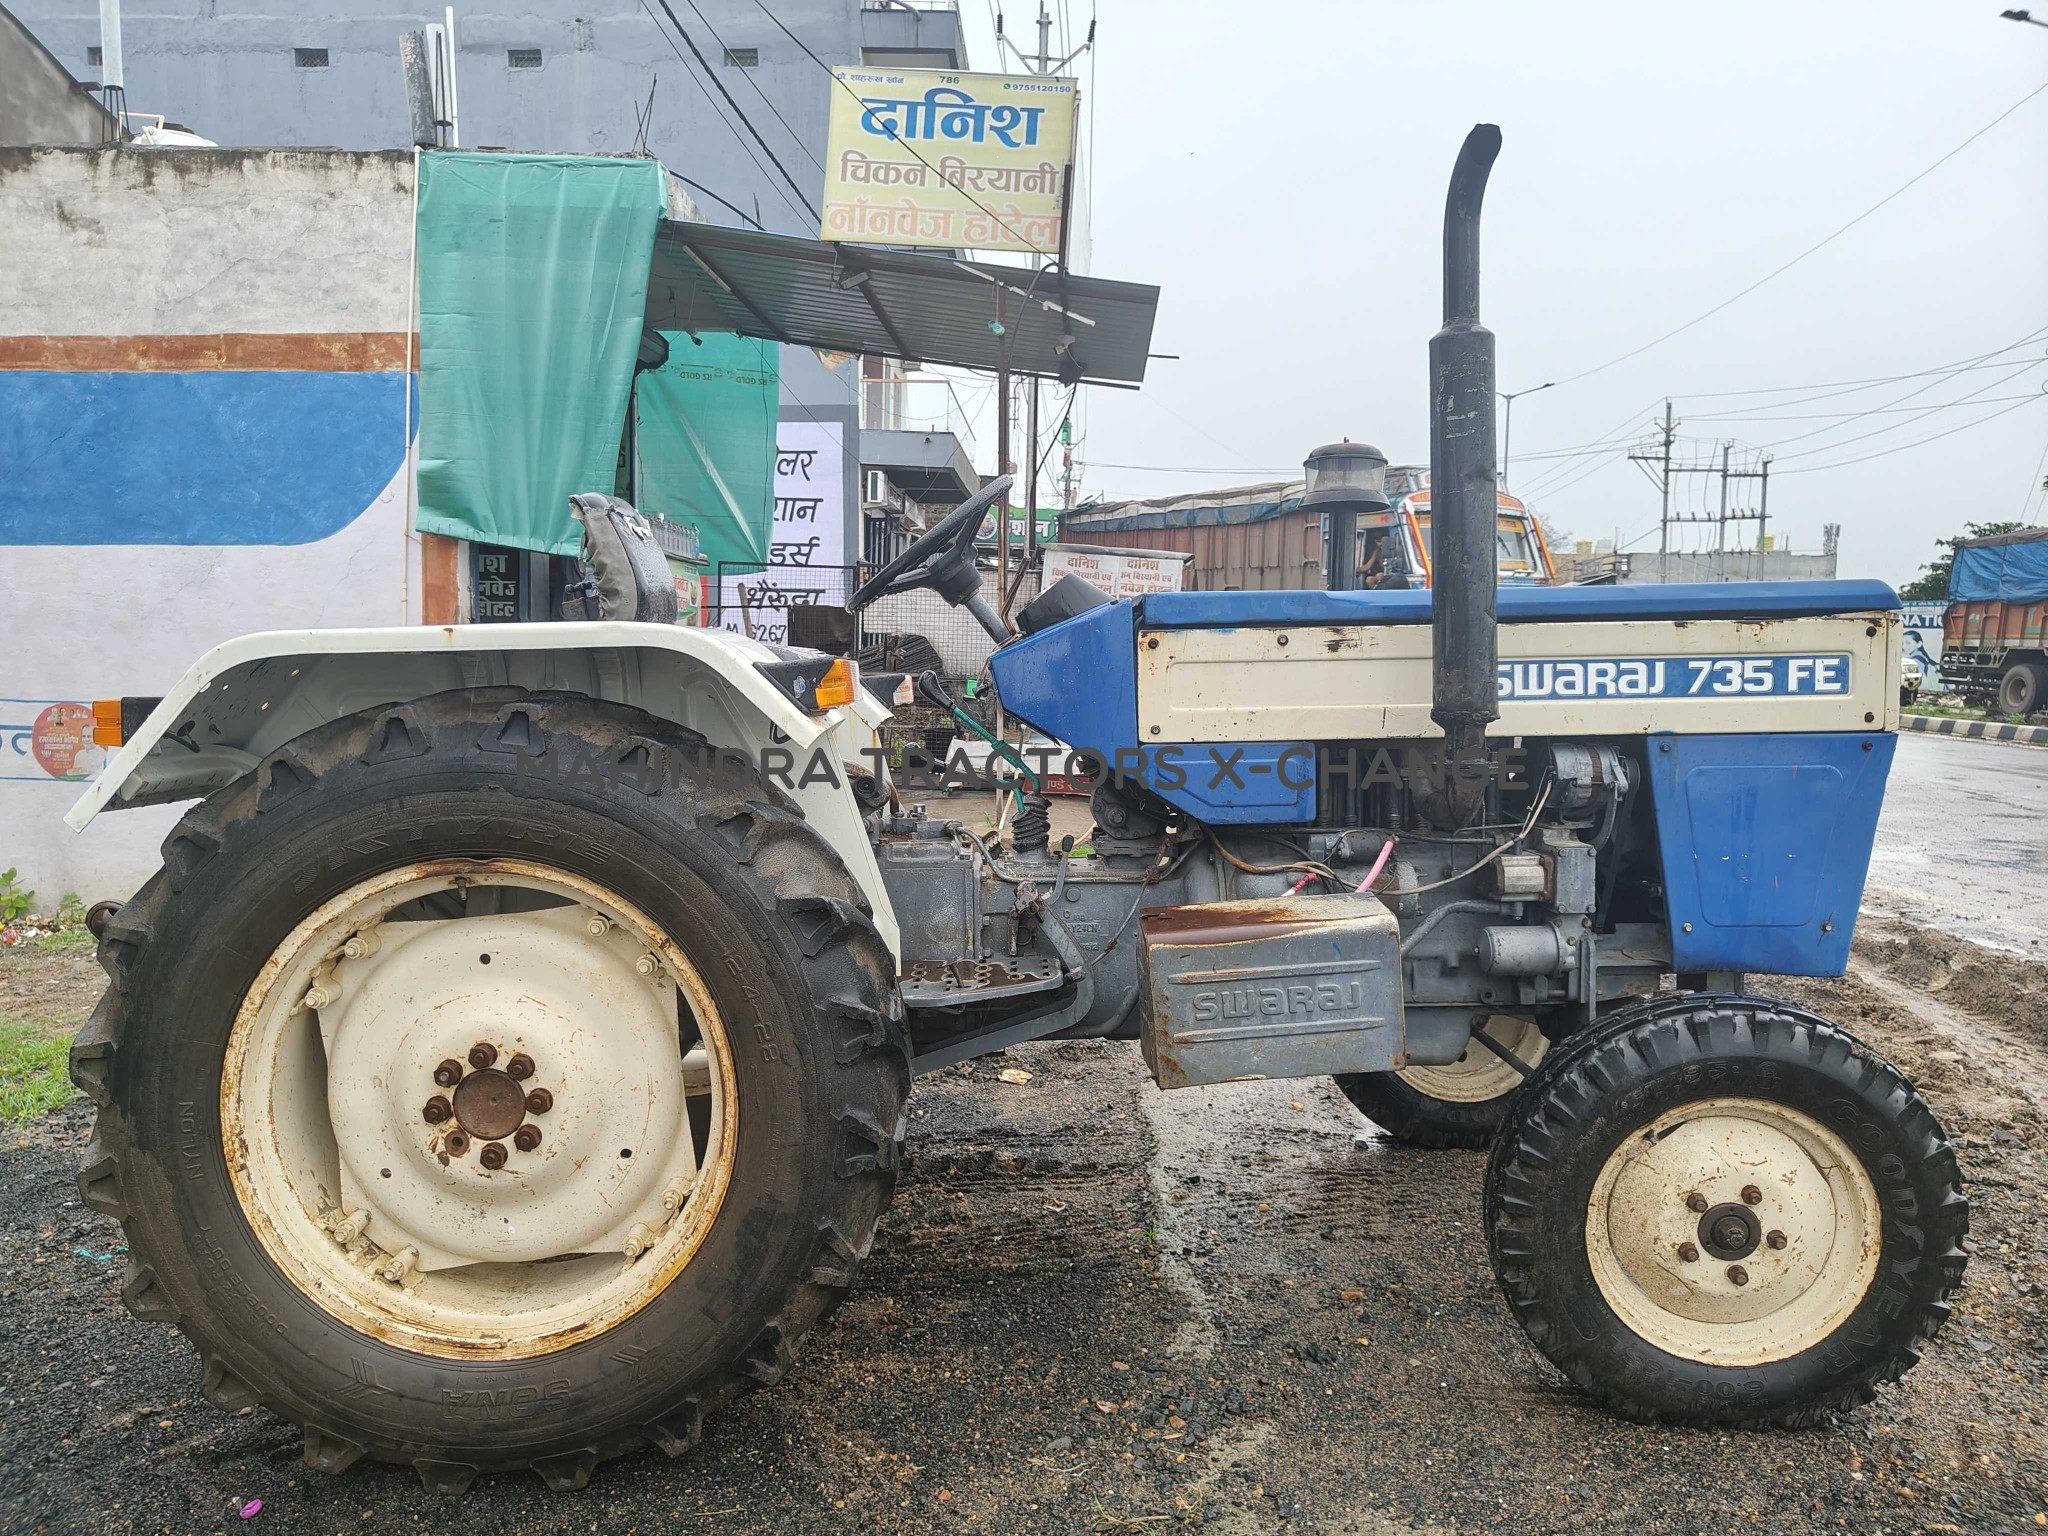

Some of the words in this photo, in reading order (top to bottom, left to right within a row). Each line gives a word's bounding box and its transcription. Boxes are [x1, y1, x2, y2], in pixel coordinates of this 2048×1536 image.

[940, 76, 960, 84] 786
[1012, 84, 1071, 93] 9755120150
[861, 87, 1045, 147] दानिश
[840, 150, 926, 187] चिकन
[939, 156, 1060, 194] बिरयानी
[828, 197, 954, 239] नॉनवेज
[963, 202, 1061, 246] होटेल
[1067, 555, 1100, 569] दानिश
[1127, 557, 1160, 571] दानिश
[1688, 659, 1774, 694] 735
[1788, 658, 1842, 692] FE
[200, 1226, 234, 1272] DUTY
[1830, 1098, 1925, 1377] GOODYEAR
[230, 1272, 290, 1336] DOUBLE
